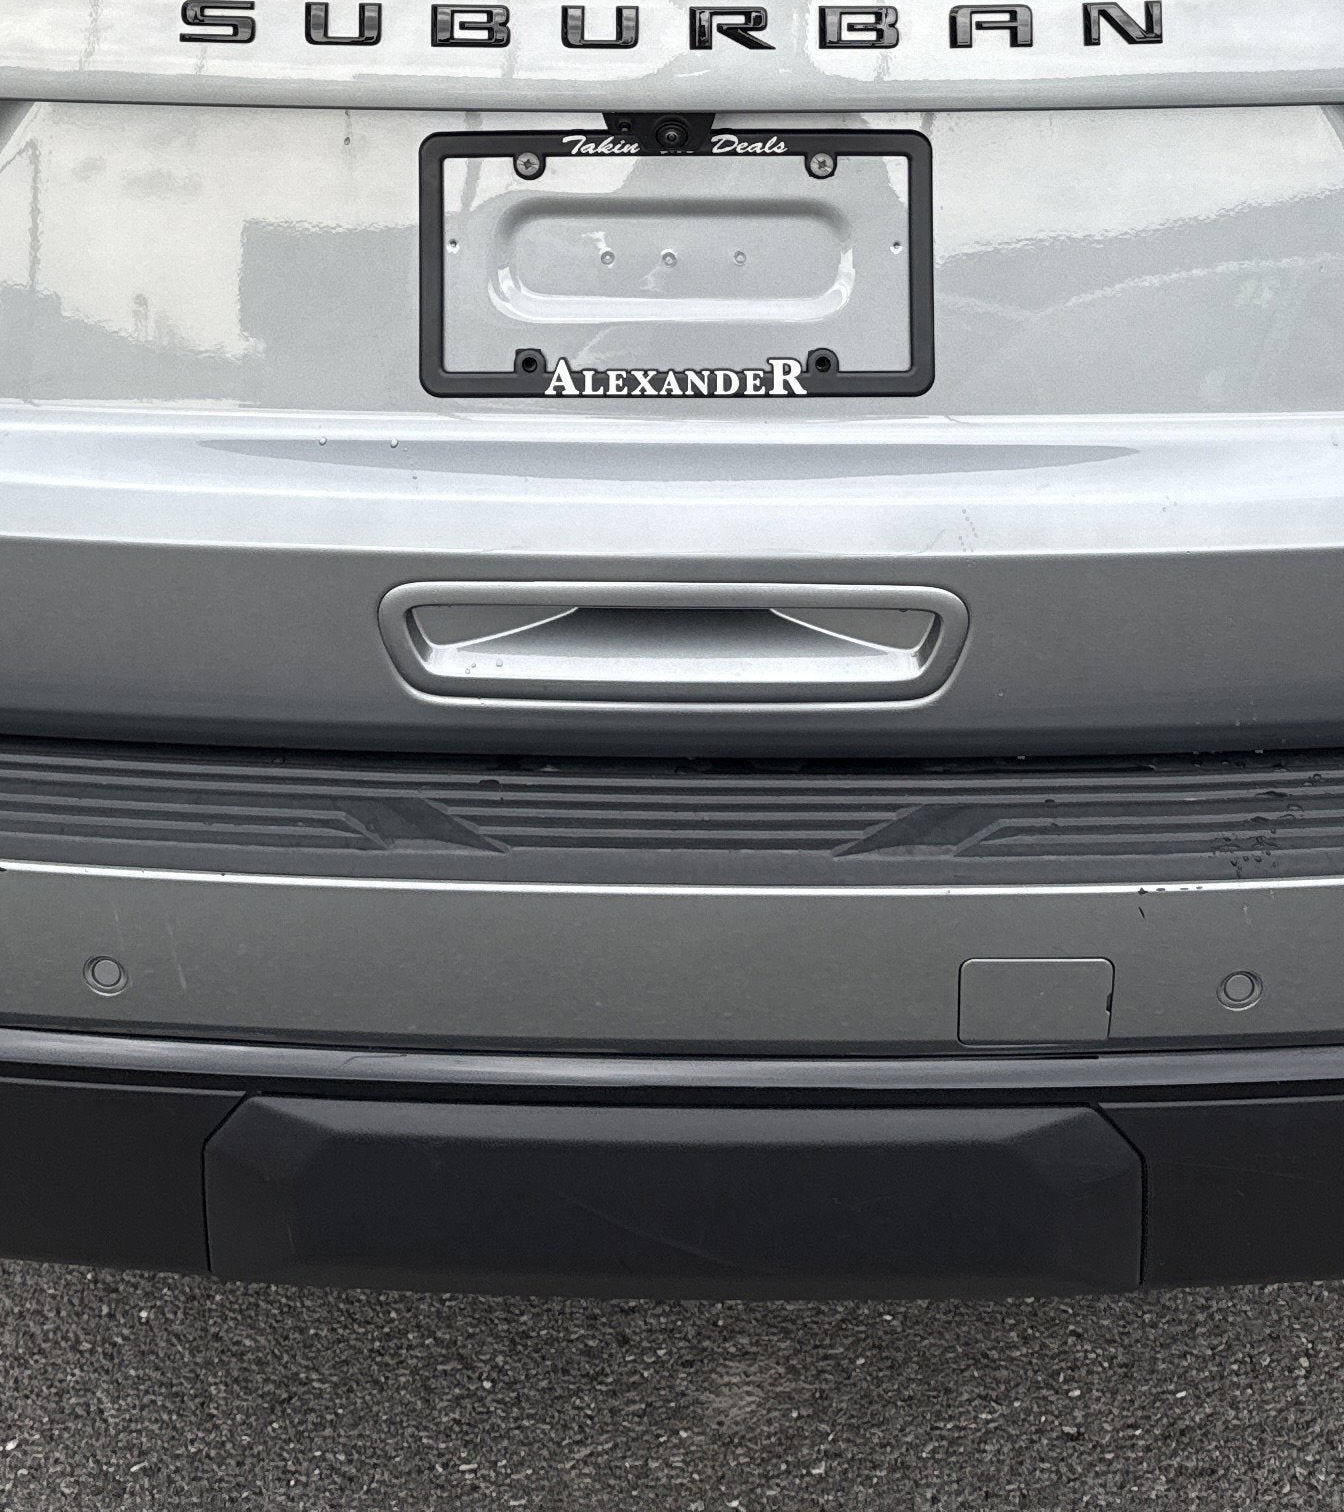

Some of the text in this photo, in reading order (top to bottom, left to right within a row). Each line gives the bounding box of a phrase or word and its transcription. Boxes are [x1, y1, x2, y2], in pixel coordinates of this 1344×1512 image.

[179, 0, 1164, 50] SUBURBAN
[562, 133, 789, 155] Takin Deals
[544, 358, 808, 396] ALEXANDER
